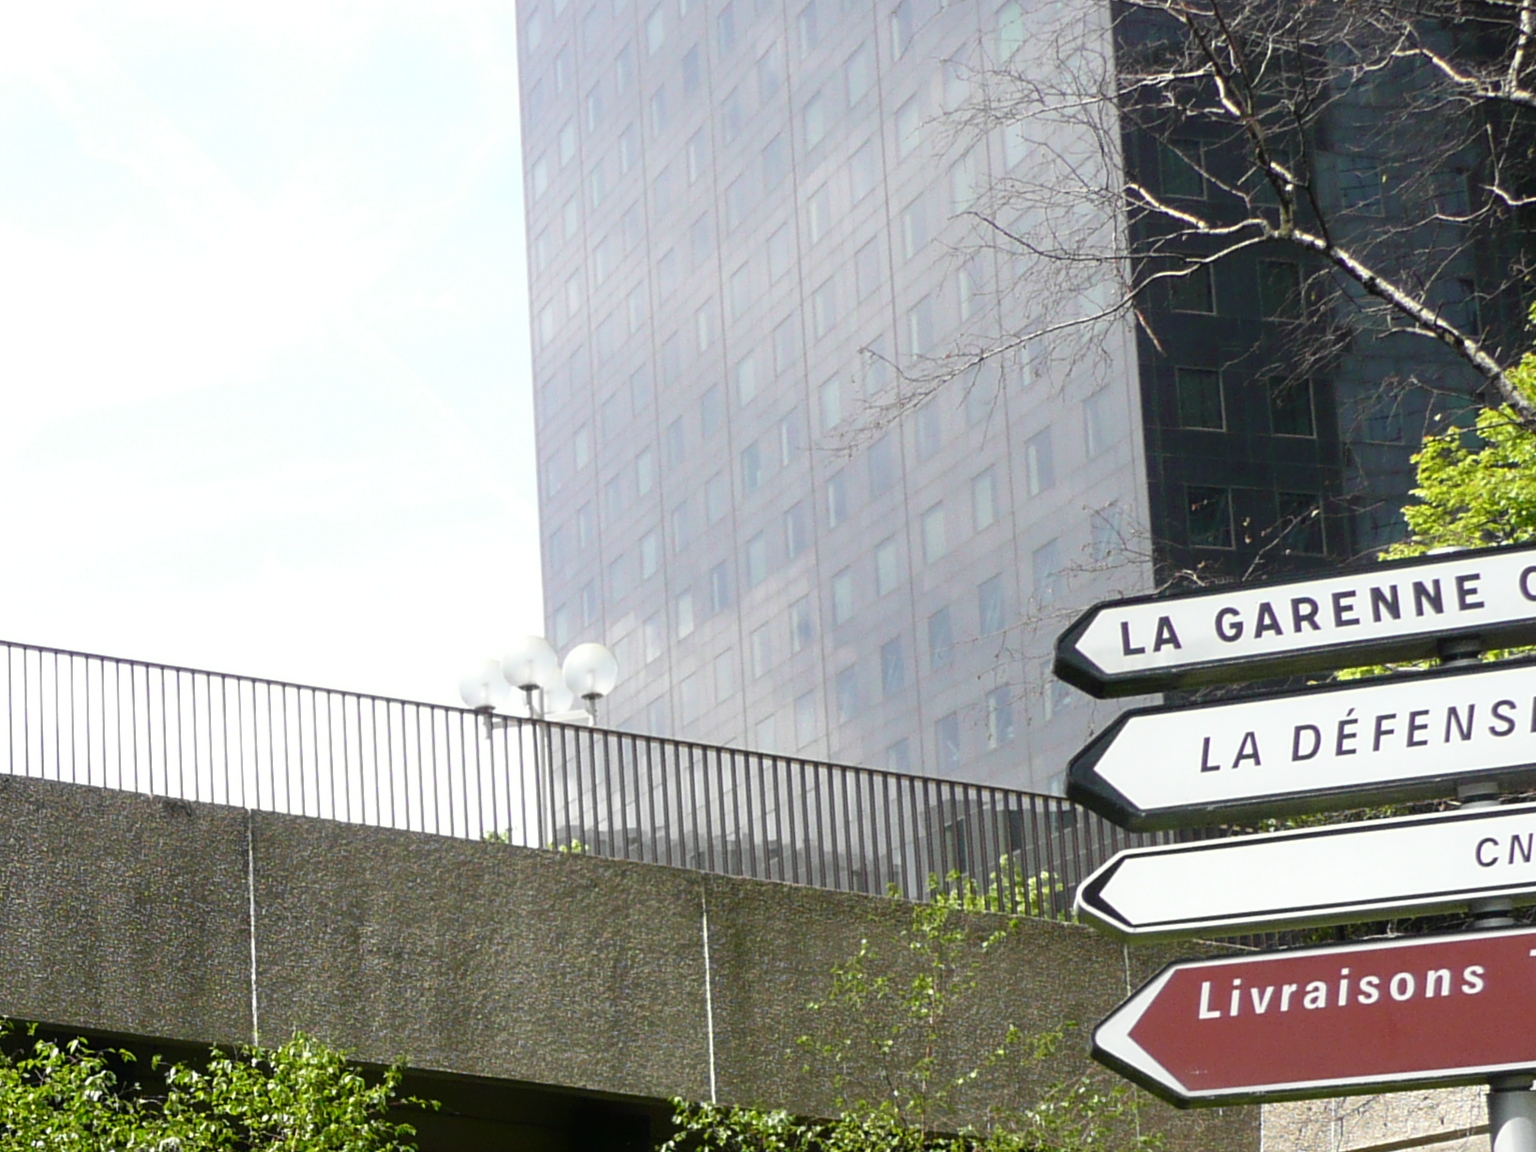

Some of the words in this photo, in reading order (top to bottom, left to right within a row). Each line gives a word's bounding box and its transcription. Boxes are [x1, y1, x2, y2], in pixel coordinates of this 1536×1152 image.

[1120, 616, 1183, 657] LA
[1215, 573, 1486, 643] GARENNE
[1200, 731, 1262, 774] LA
[1291, 696, 1536, 763] DÉFENS
[1198, 965, 1486, 1020] Livraisons
